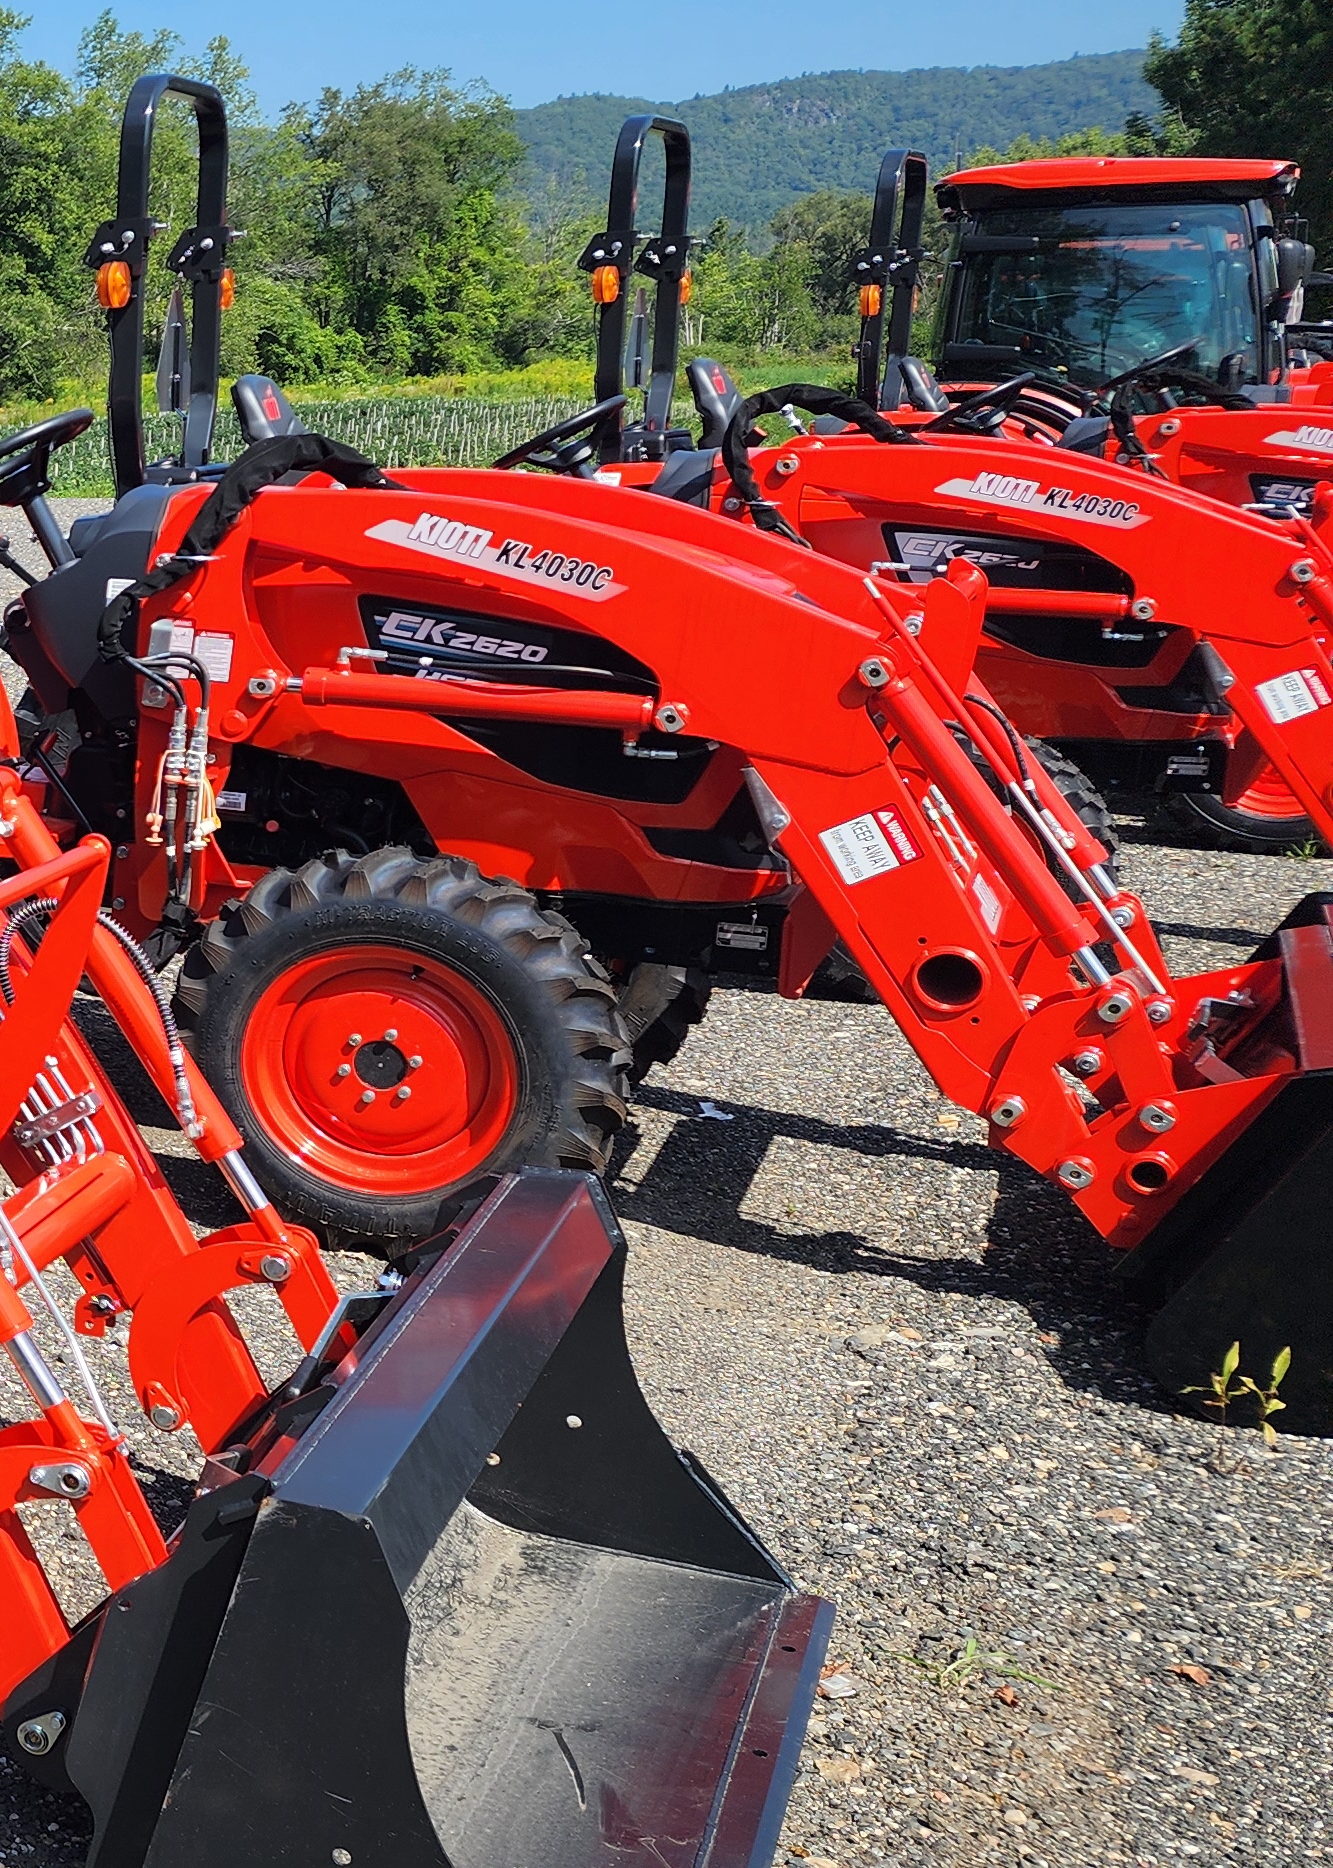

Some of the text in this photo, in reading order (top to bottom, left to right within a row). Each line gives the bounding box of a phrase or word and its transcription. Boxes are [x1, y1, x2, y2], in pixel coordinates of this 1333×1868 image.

[970, 471, 1139, 522] KIOTI KL4030C
[407, 512, 614, 592] KIOTI KL4030C
[382, 611, 549, 663] CK2620
[849, 818, 891, 871] KEEP AWAY
[886, 820, 917, 861] WARNING
